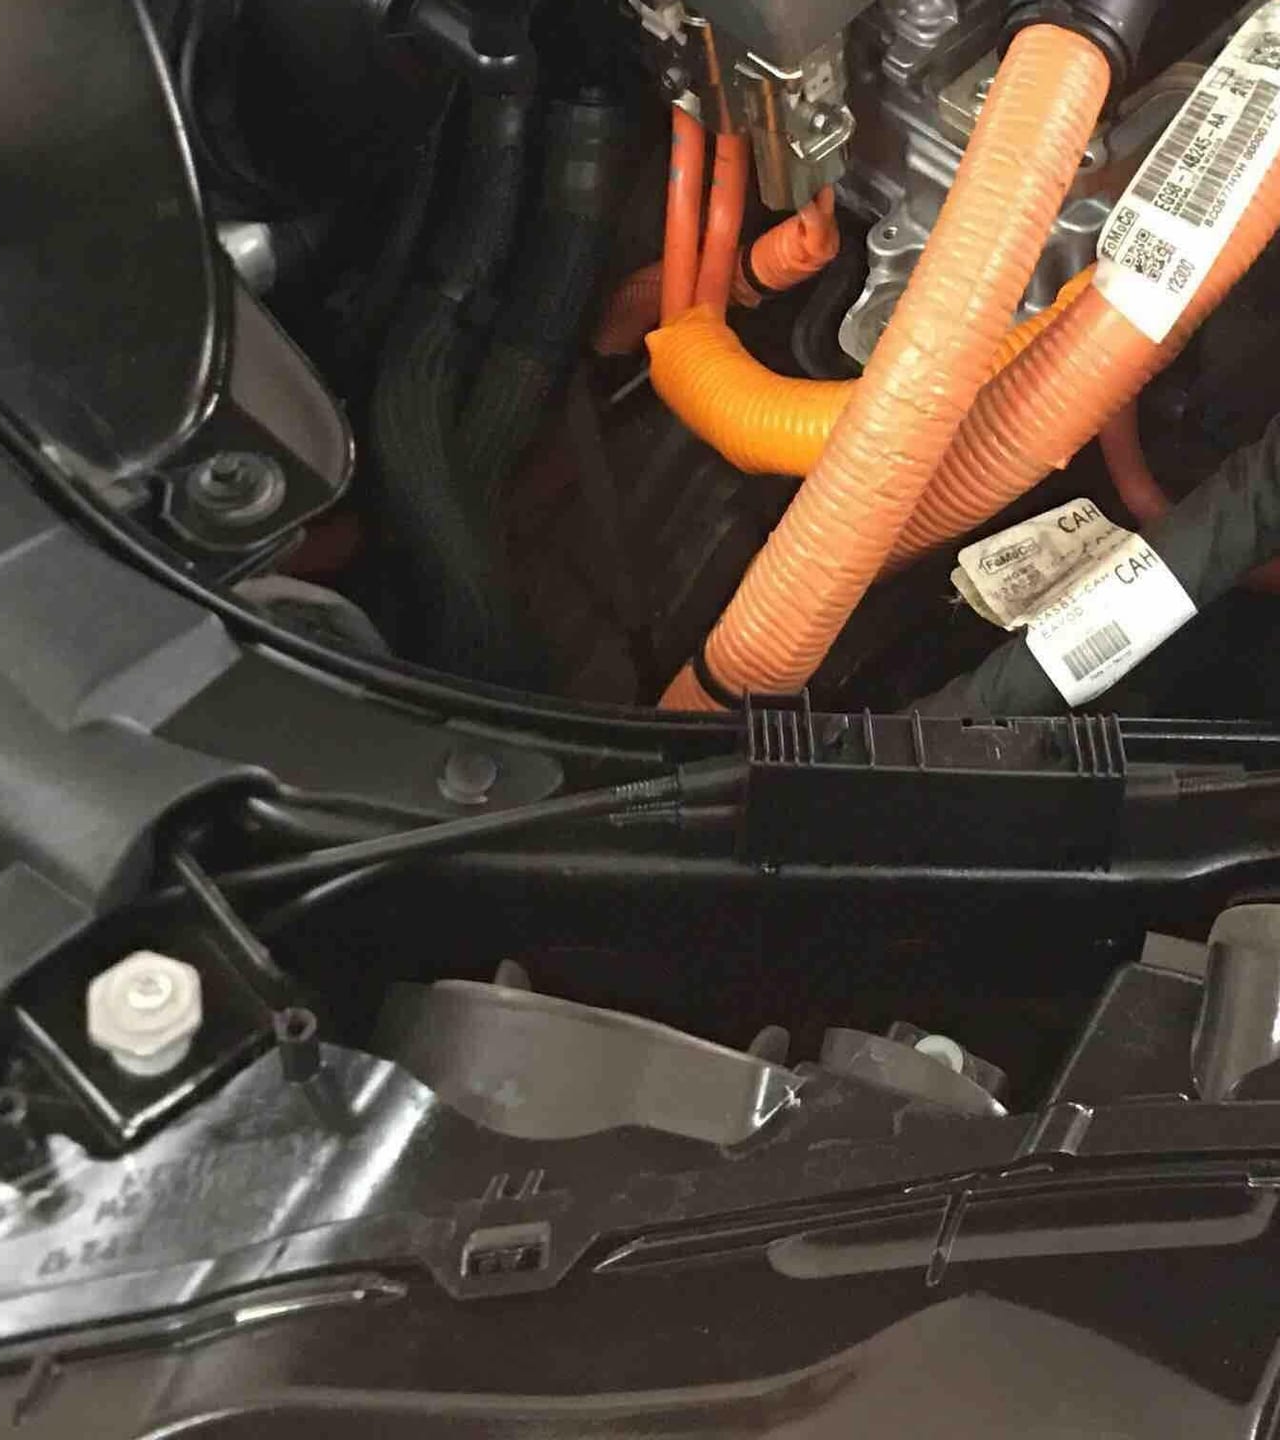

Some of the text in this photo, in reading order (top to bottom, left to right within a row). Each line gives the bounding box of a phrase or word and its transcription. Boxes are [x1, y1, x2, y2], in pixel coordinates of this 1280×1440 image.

[1101, 210, 1135, 258] FoMoCo
[1057, 503, 1101, 533] CAH
[1114, 548, 1158, 585] CAH
